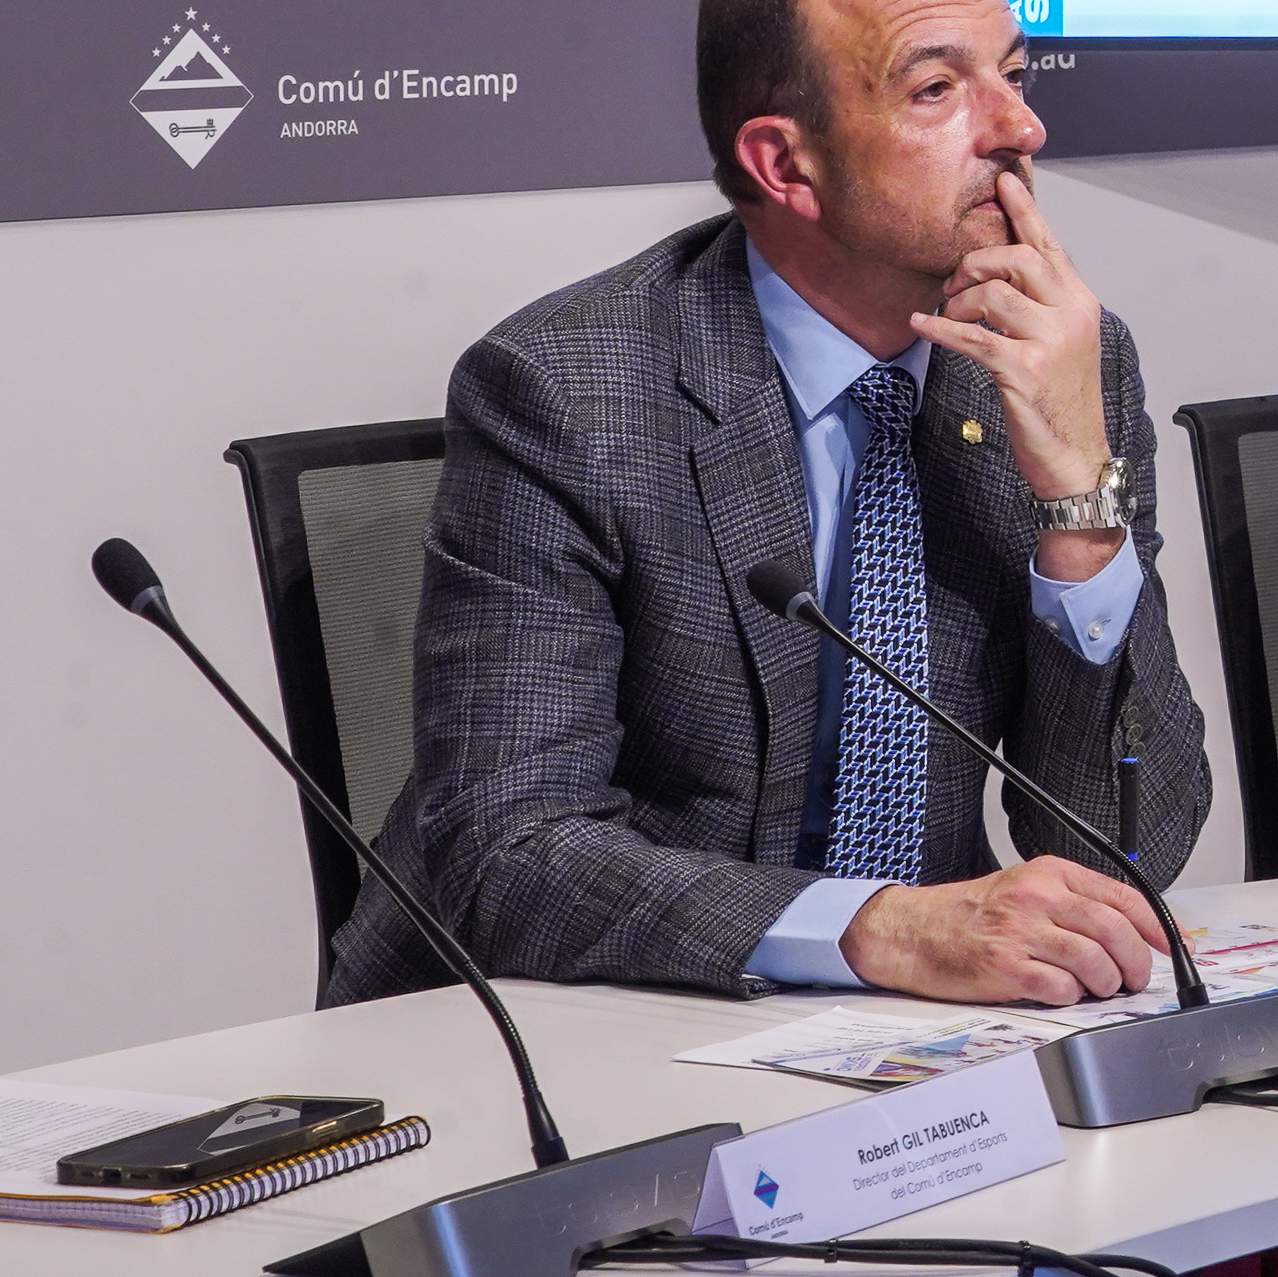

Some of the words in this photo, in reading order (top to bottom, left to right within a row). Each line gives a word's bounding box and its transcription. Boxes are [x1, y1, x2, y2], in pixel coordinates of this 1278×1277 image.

[279, 70, 363, 104] Comú
[281, 120, 358, 138] ANDORRA
[858, 1139, 899, 1165] Robert
[902, 1132, 923, 1150] GIL
[925, 1110, 990, 1142] TABUENCA
[853, 1171, 889, 1190] Director
[908, 1145, 968, 1174] Departament
[907, 1179, 935, 1194] Comú
